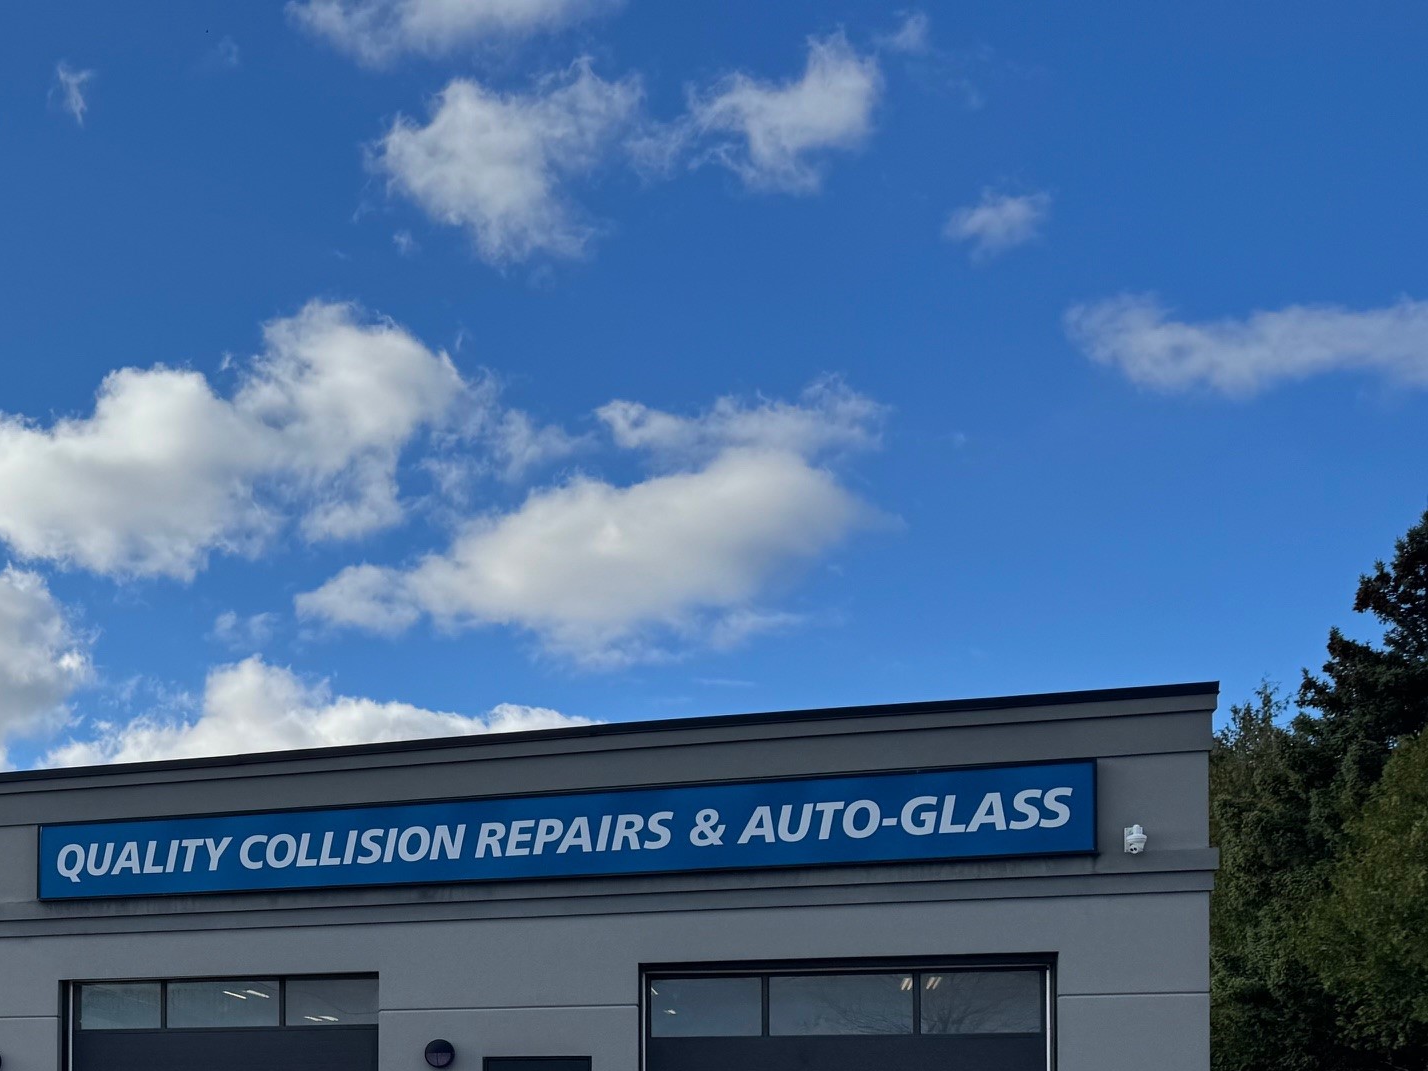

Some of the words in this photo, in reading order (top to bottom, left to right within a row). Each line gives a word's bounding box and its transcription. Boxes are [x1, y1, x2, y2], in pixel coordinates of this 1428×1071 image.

[57, 837, 232, 882] QUALITY
[239, 824, 466, 869] COLLISION
[475, 812, 673, 857] REPAIRS
[689, 808, 726, 846] &
[738, 787, 1073, 843] AUTO-GLASS
